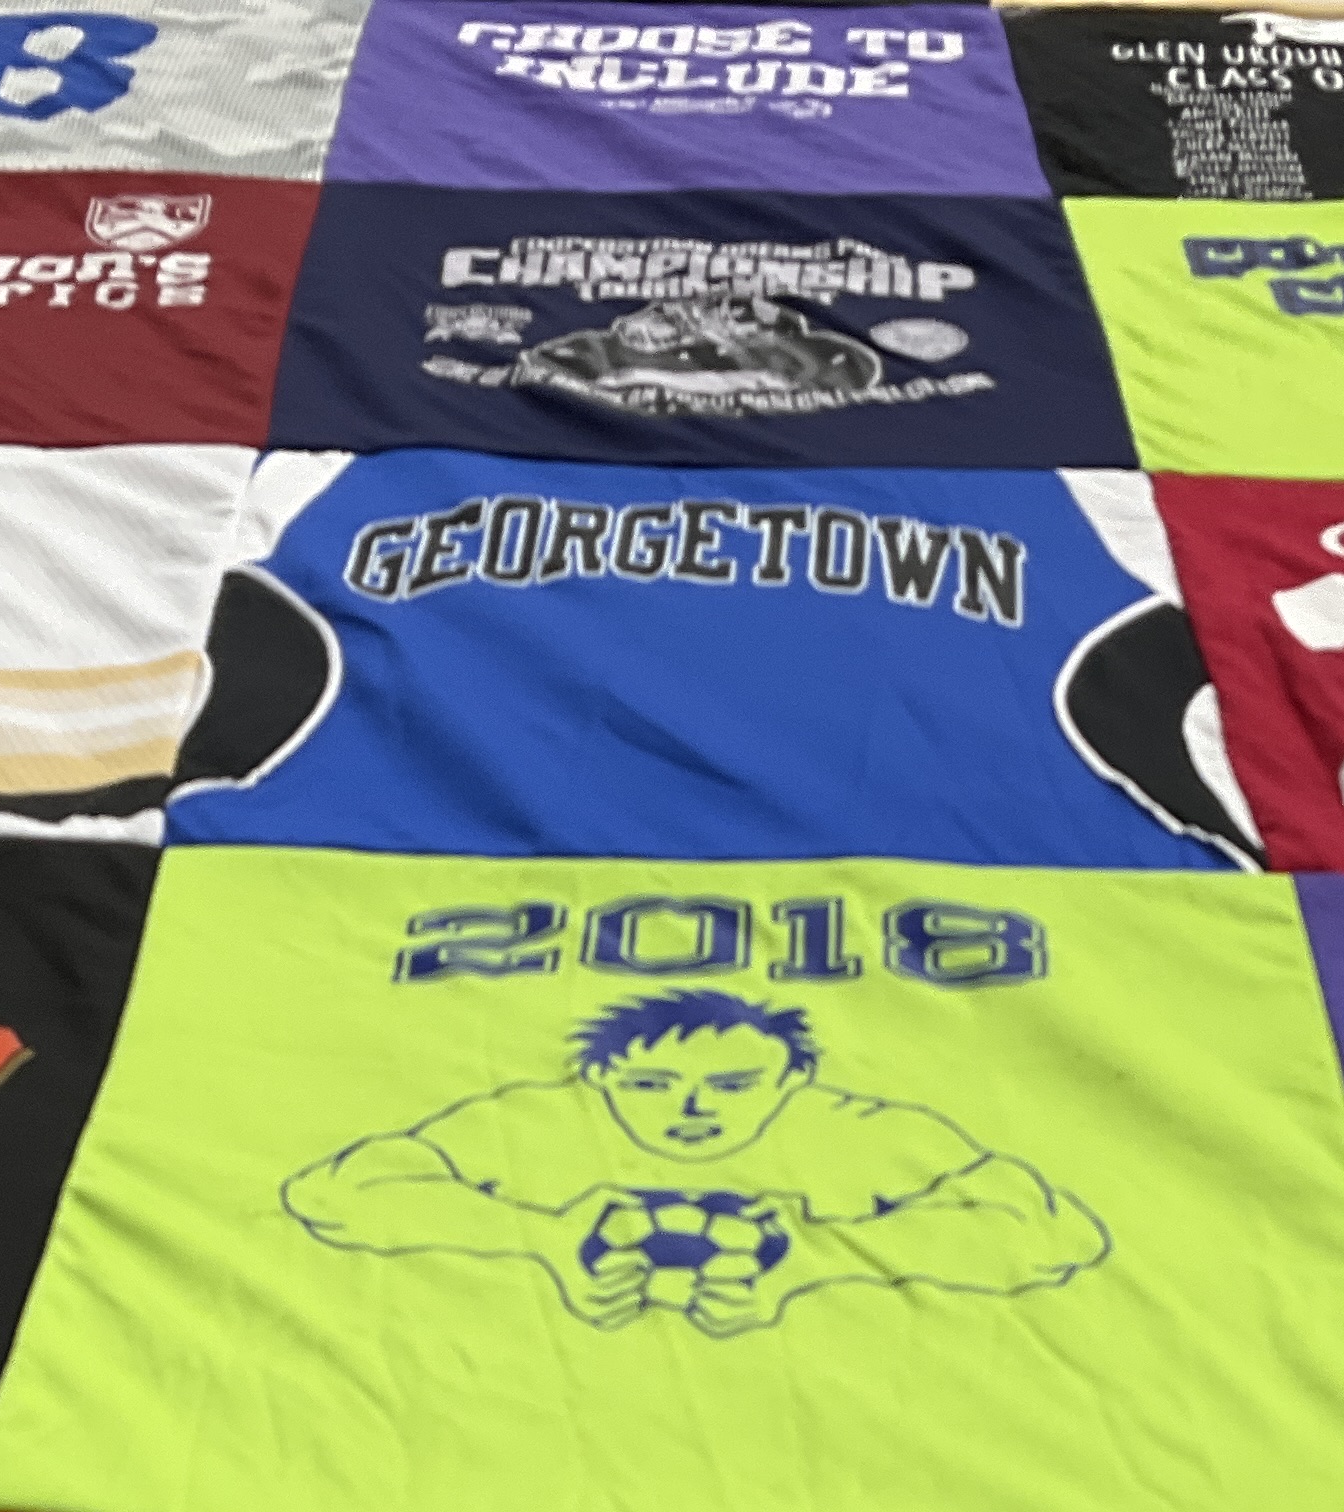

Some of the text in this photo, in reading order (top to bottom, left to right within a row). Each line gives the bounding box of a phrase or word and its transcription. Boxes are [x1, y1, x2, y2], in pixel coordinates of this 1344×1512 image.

[847, 28, 965, 63] TO
[344, 493, 1027, 629] GEORGETOWN
[391, 895, 1052, 990] 2018
